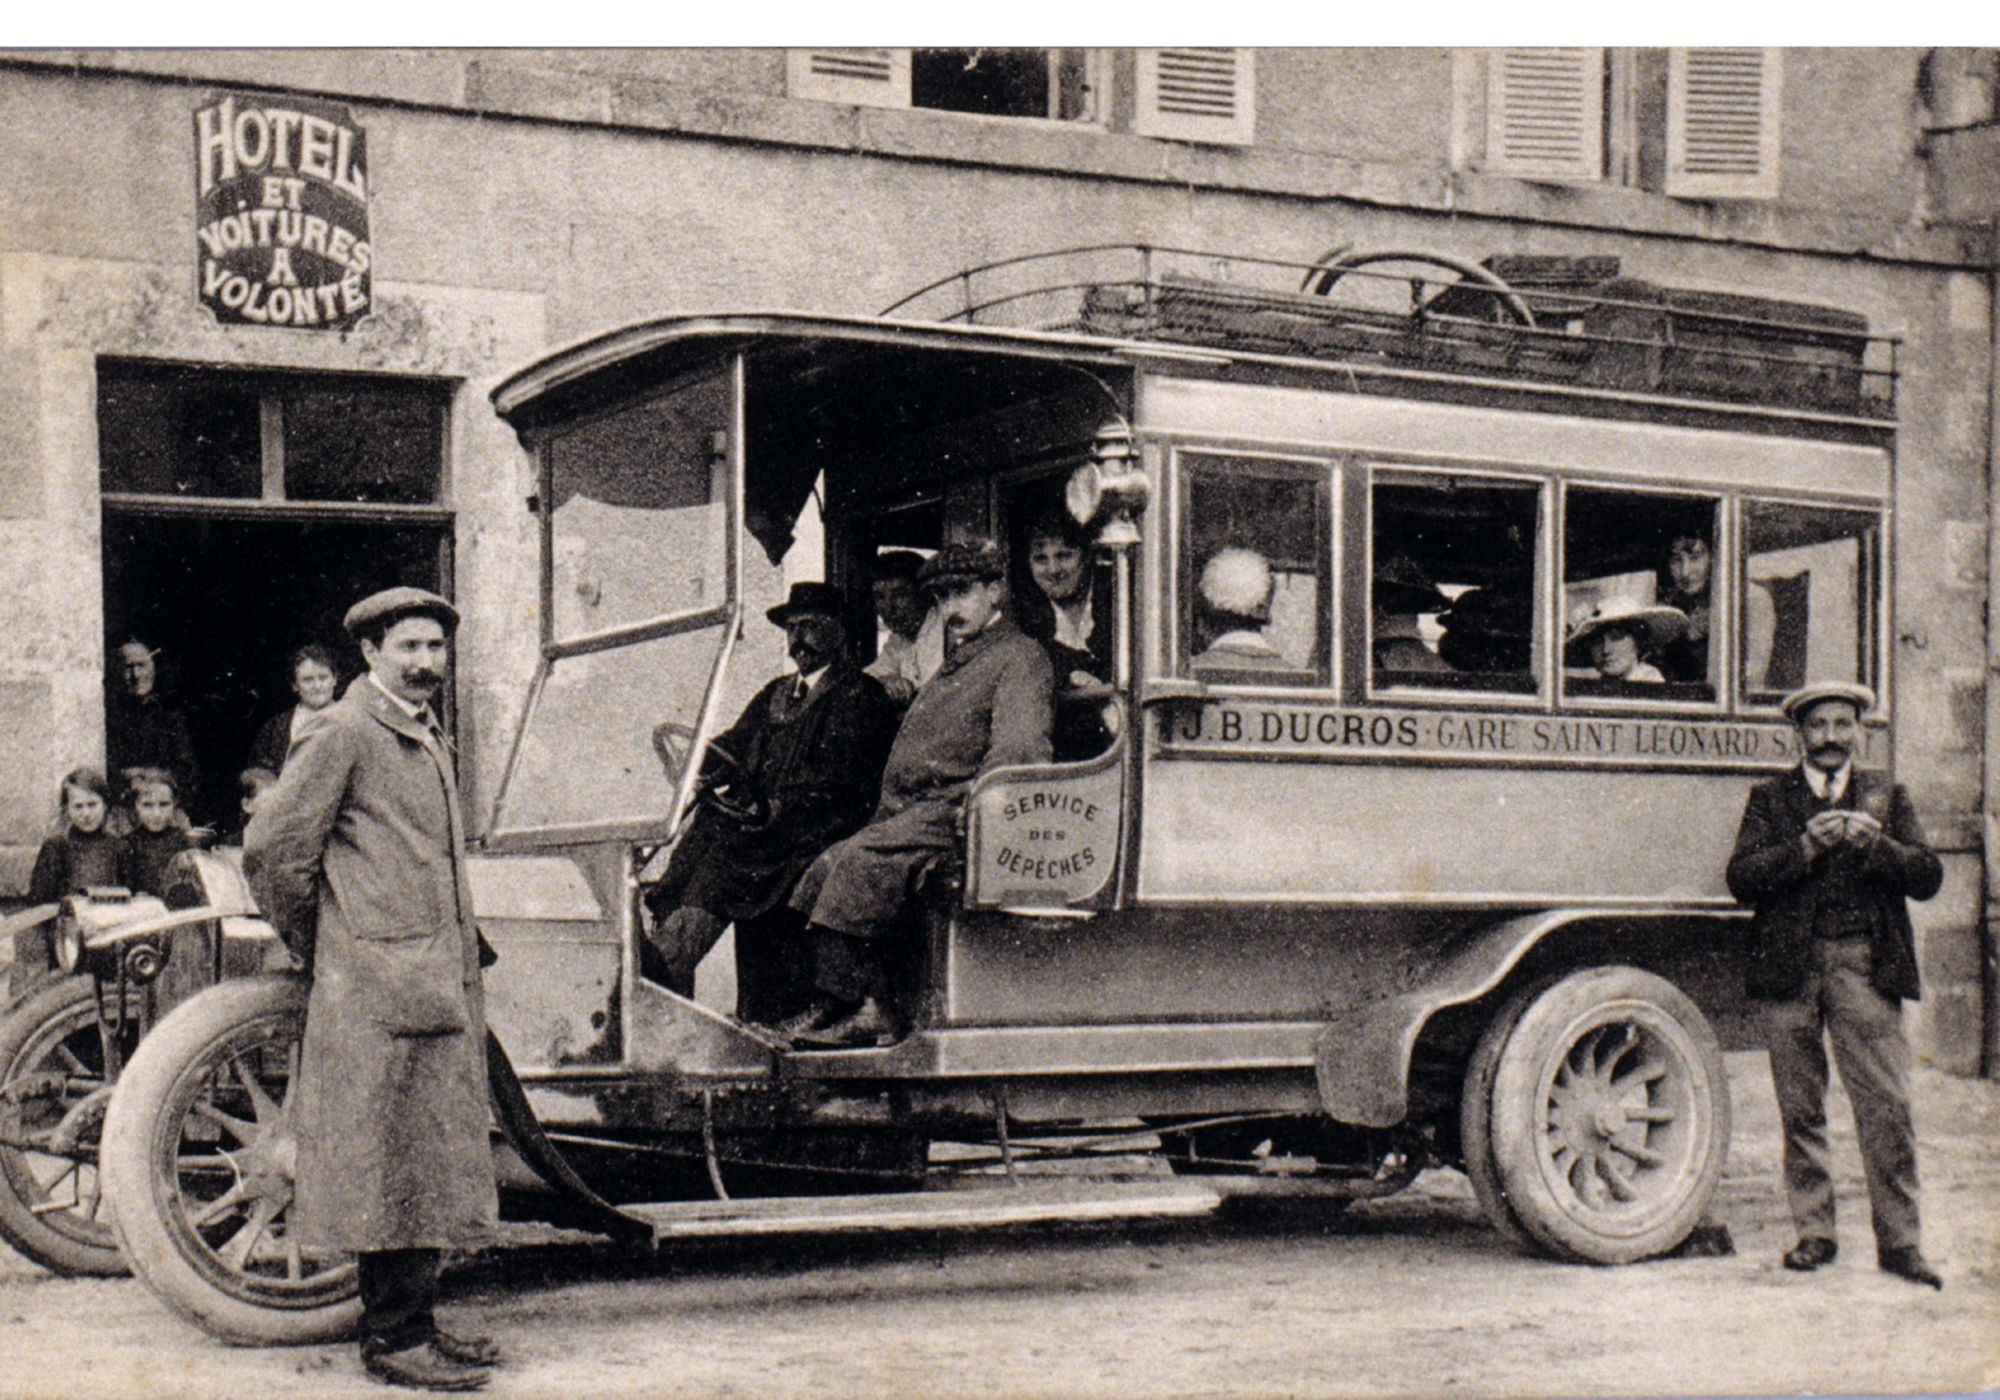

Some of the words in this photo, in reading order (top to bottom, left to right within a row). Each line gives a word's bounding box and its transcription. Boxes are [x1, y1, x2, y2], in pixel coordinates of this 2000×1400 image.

[197, 97, 366, 201] HOTEL
[262, 176, 306, 210] ET
[198, 201, 371, 274] VOITURES
[266, 247, 298, 286] A
[1437, 717, 1516, 750] GARE
[1533, 721, 1623, 754] SAINT
[1003, 793, 1098, 822] SERVICE
[1029, 830, 1066, 841] DES
